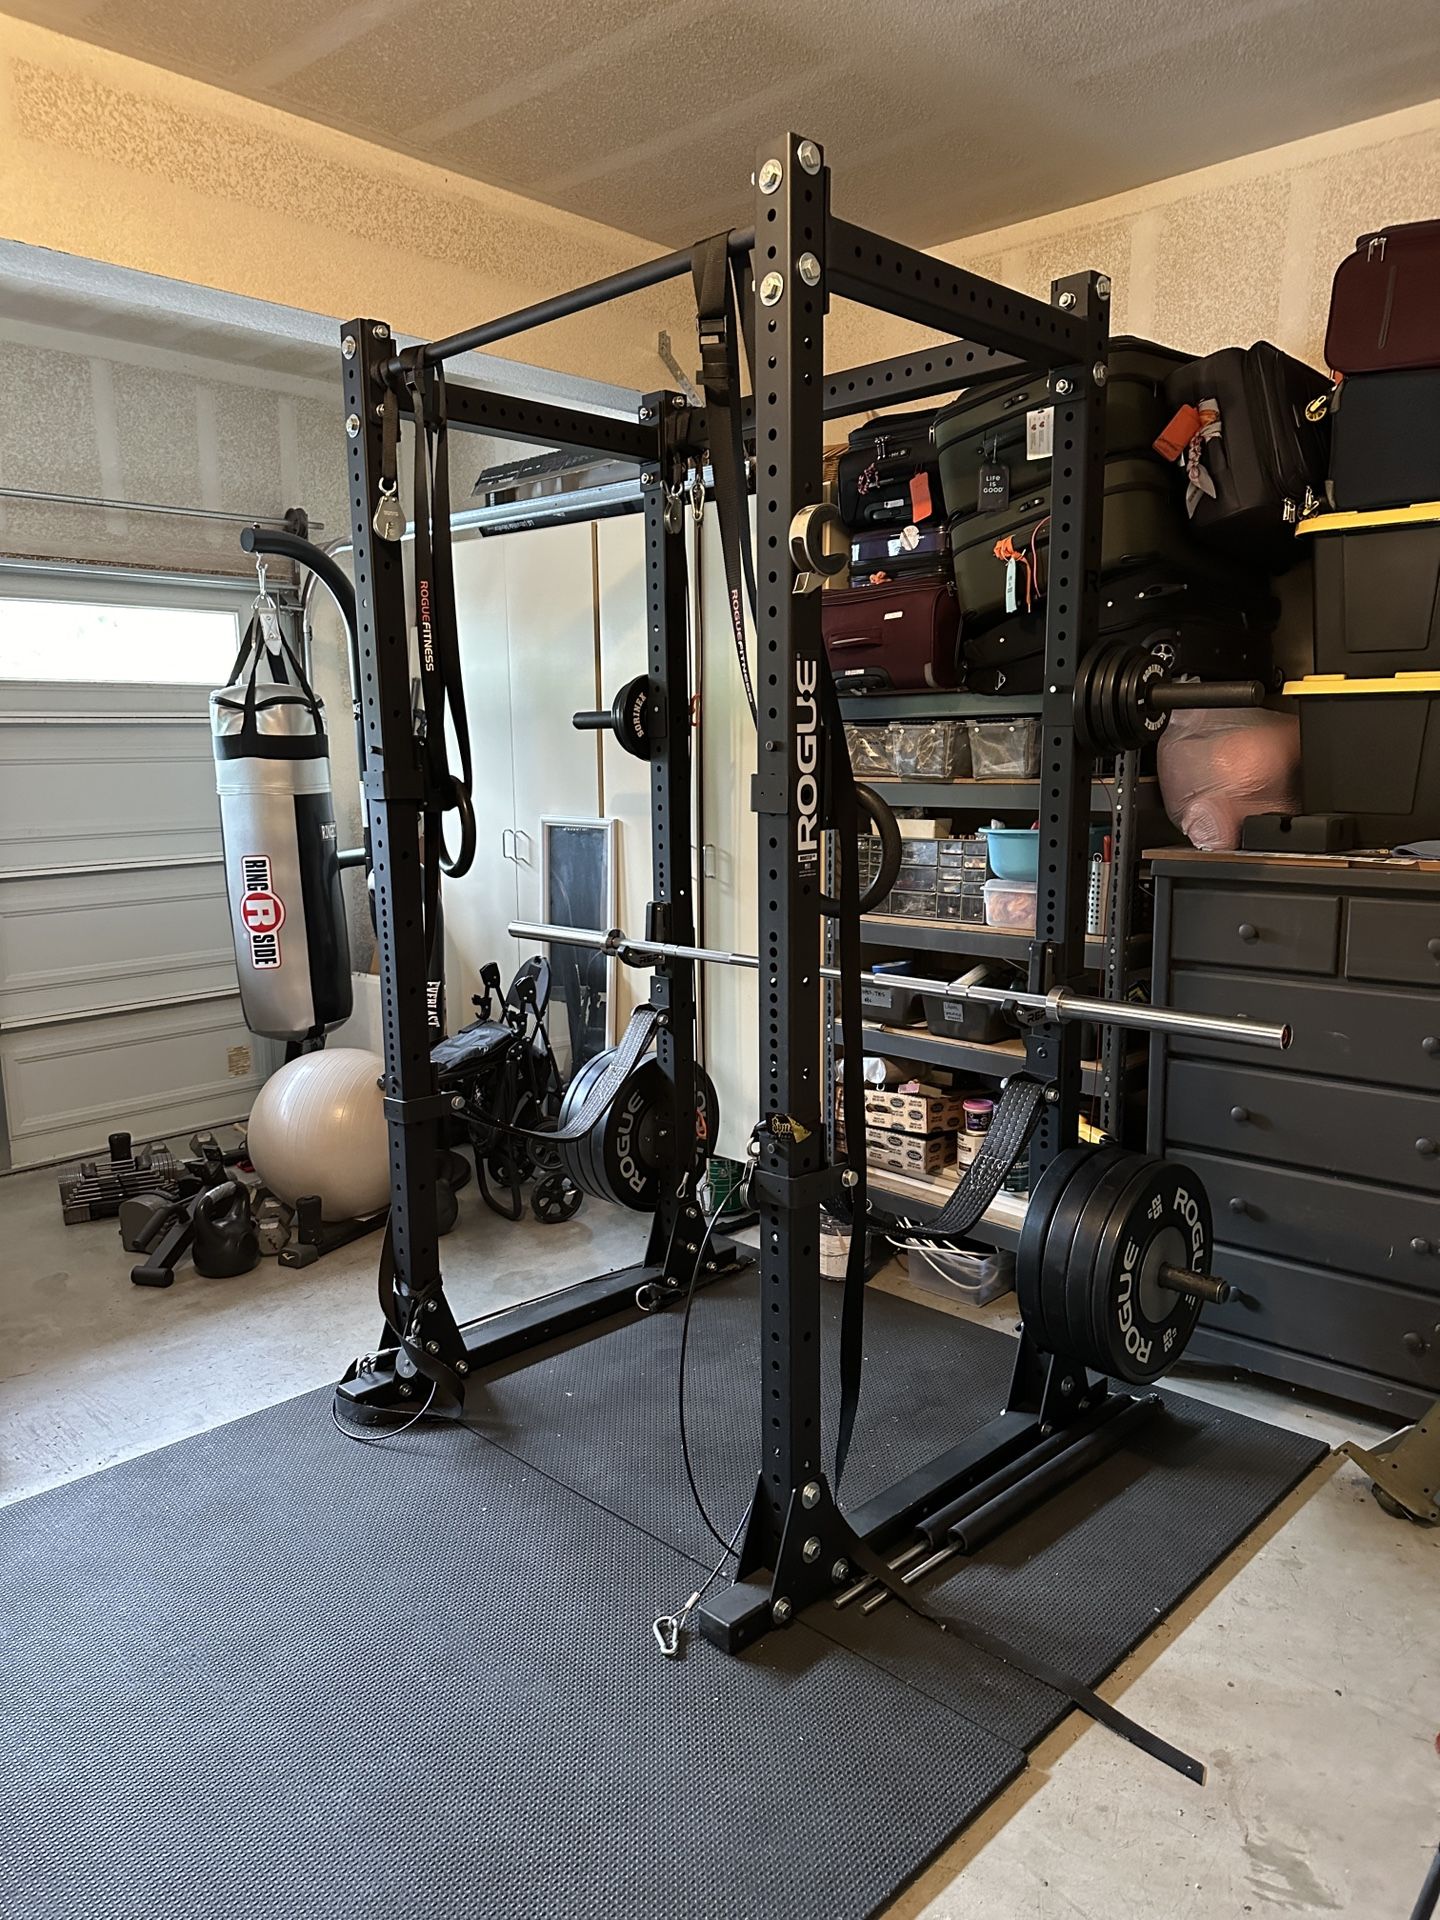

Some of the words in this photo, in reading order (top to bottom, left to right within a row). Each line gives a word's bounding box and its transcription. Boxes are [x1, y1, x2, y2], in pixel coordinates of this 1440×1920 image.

[632, 691, 647, 738] SORINEX
[797, 659, 817, 851] ROGUE
[244, 859, 269, 892] RING
[246, 899, 276, 927] R
[252, 934, 277, 965] SIDE
[426, 981, 442, 1028] EVERLAST
[616, 1090, 648, 1194] ROGUE
[1117, 1239, 1153, 1364] ROGUE
